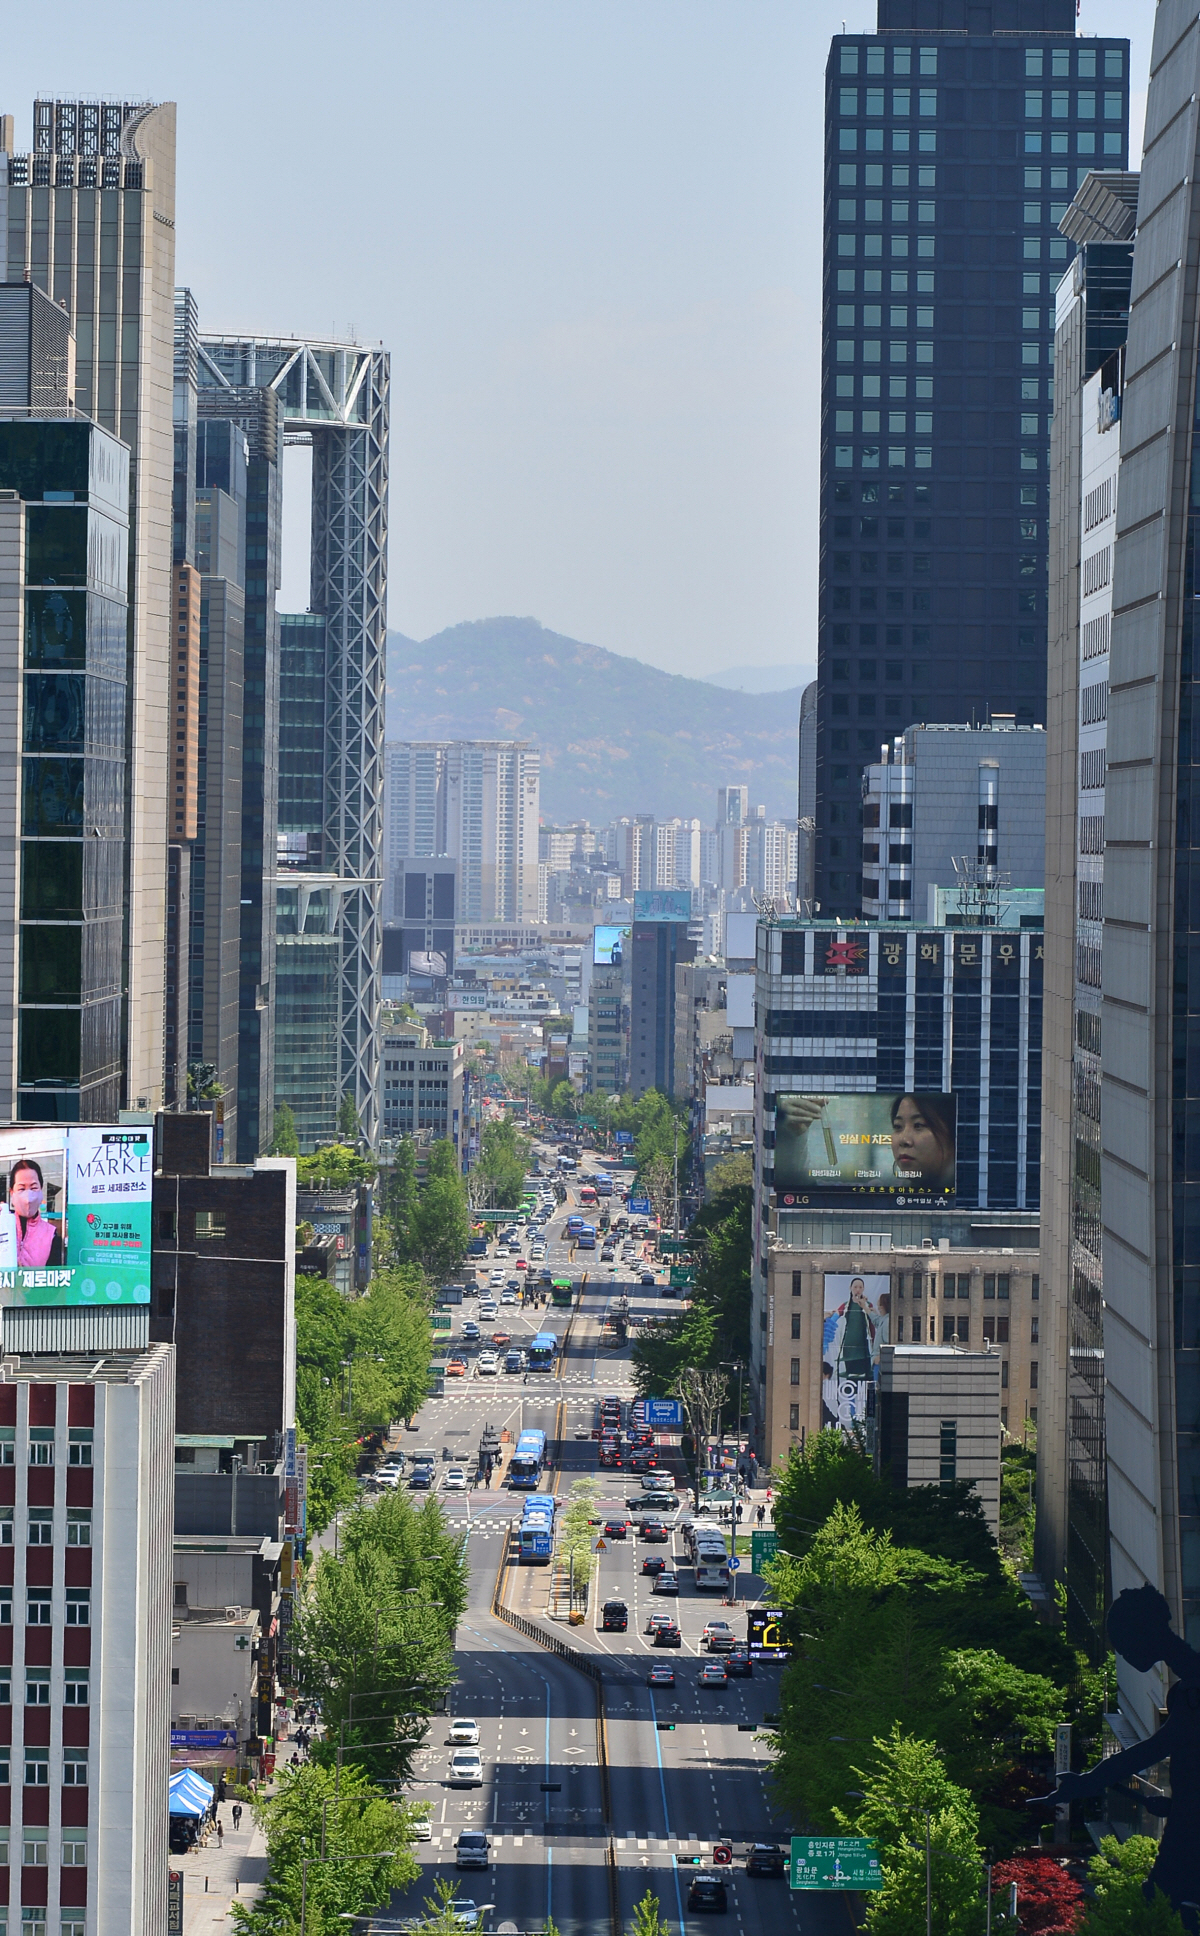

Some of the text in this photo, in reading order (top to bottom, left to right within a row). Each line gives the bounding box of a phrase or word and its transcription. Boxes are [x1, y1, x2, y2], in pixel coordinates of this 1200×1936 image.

[462, 995, 485, 1005] 한의원
[839, 1134, 892, 1145] 임실 N 치즈
[91, 1181, 147, 1194] 셀프 세제충전소
[796, 1195, 809, 1204] LG
[279, 1710, 288, 1720] 약
[808, 1841, 836, 1849] 흥인지문
